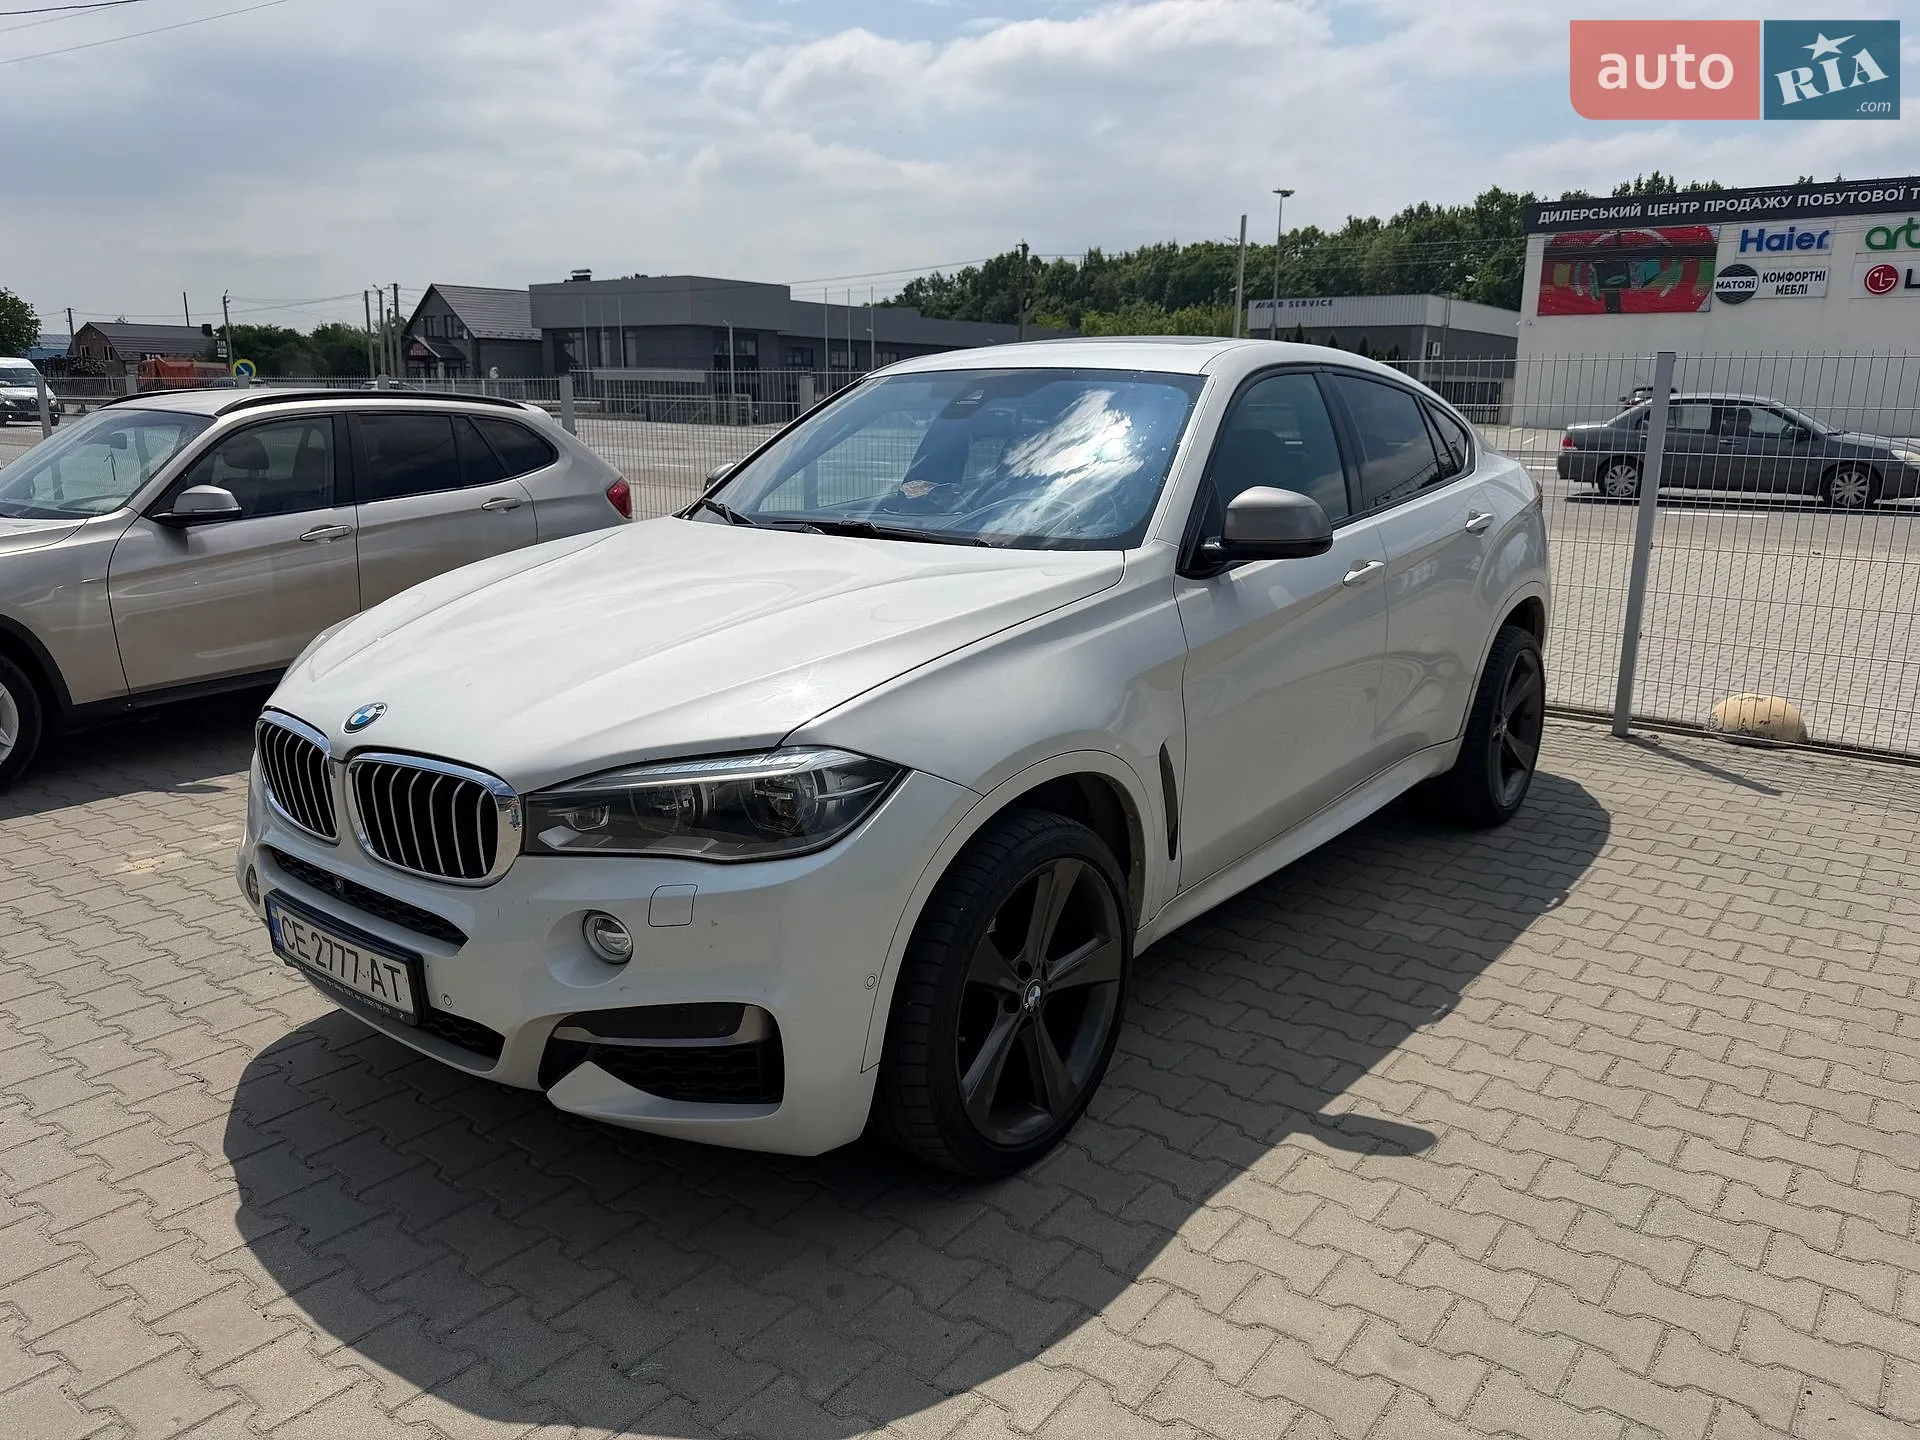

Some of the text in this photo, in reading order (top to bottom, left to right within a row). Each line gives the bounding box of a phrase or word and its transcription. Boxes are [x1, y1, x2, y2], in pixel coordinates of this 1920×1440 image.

[1538, 185, 1920, 225] ДИЛЕРСЬКИЙ ЦЕНТР ПРОДАЖУ ПОБУТОВОЇ Т
[1739, 226, 1830, 253] Haier
[1762, 270, 1826, 283] КОМФОРТНІ
[1775, 284, 1808, 296] МЕБЛІ
[1288, 299, 1334, 308] SERVICE
[281, 916, 310, 961] CE
[311, 931, 359, 984] 2777
[370, 958, 401, 1003] AT
